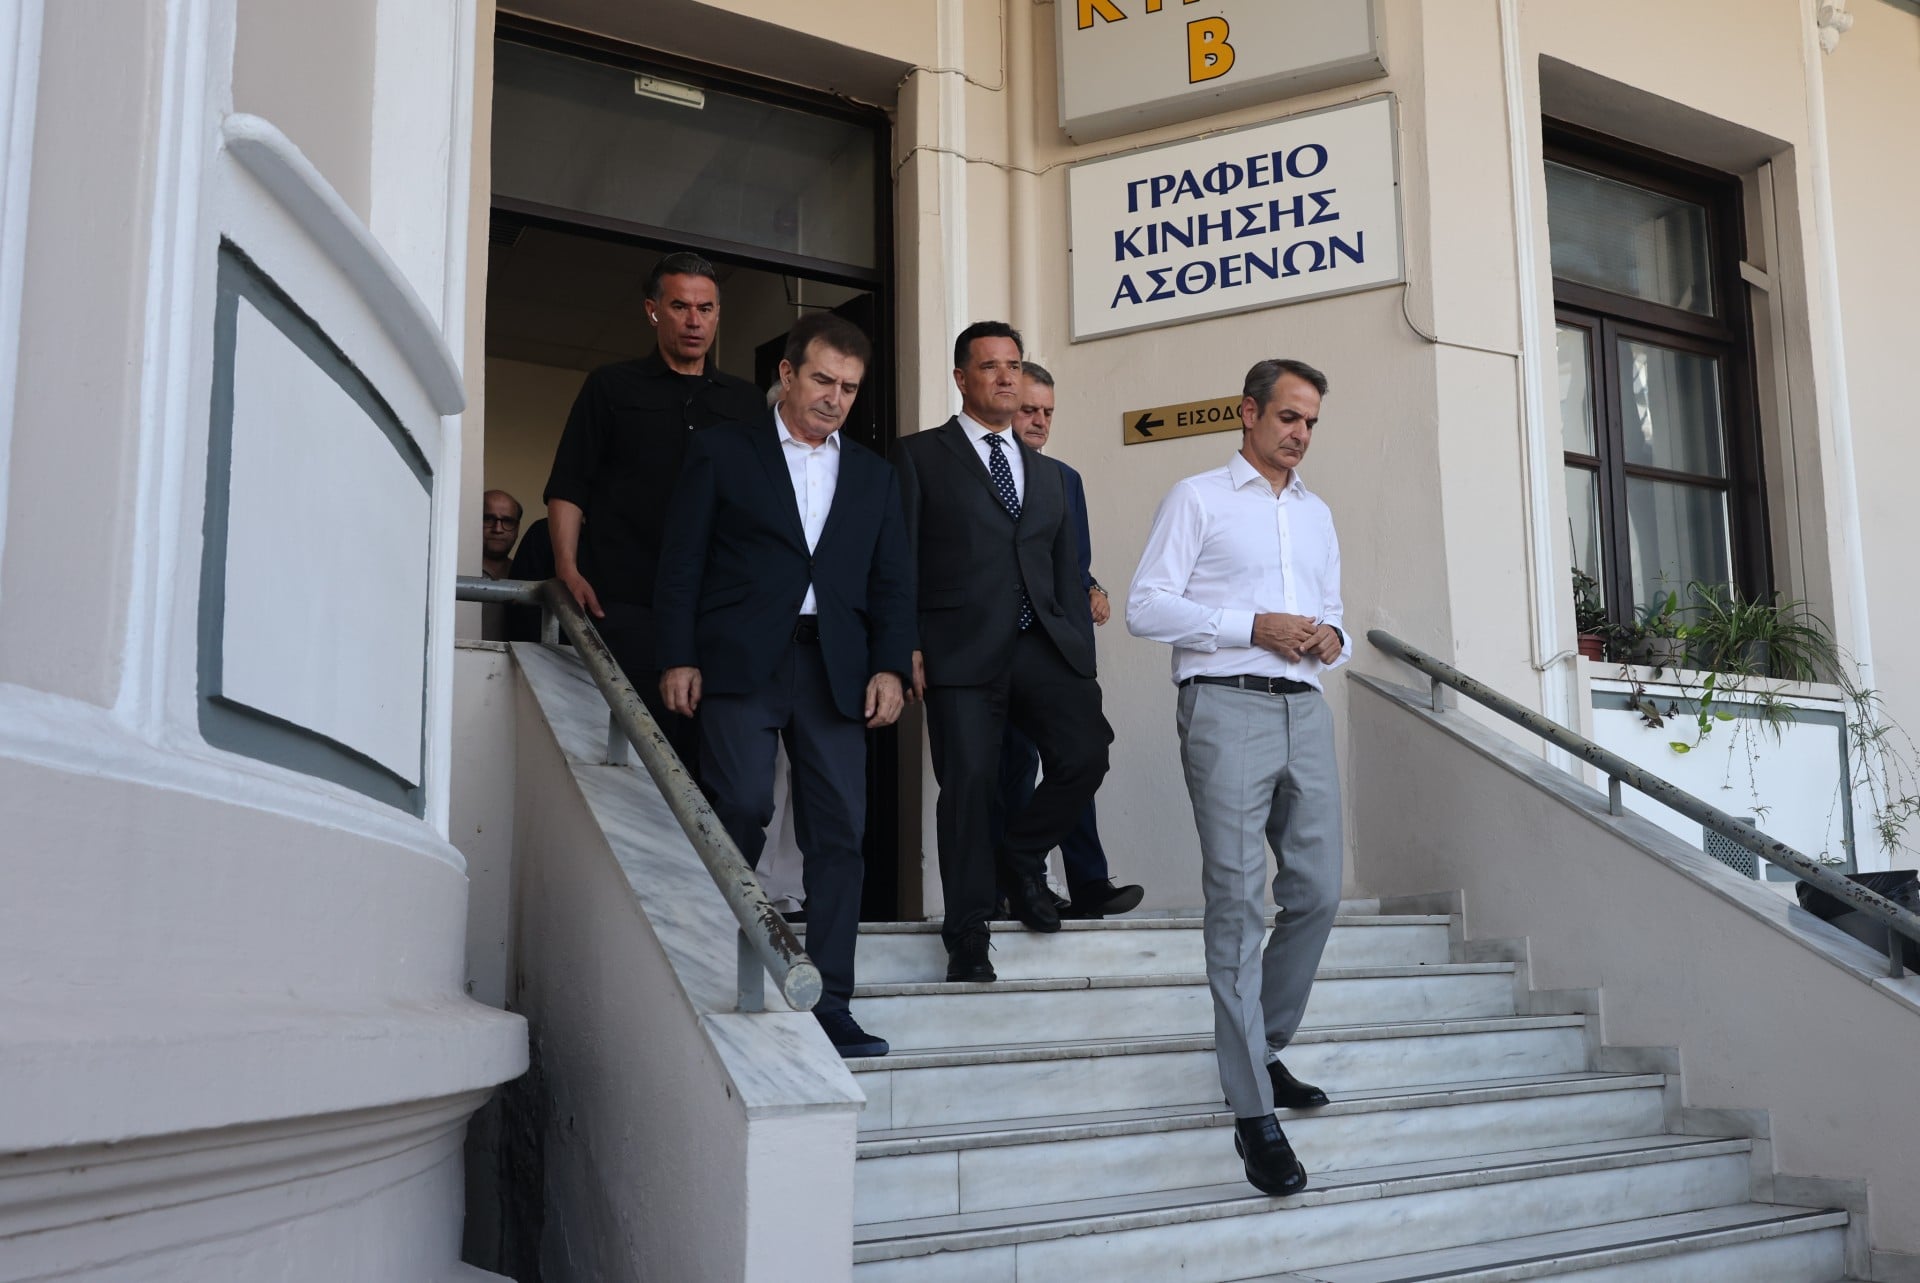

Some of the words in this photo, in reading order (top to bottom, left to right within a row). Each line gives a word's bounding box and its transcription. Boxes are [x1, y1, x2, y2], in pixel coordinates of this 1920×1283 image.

[1187, 17, 1235, 84] Β
[1128, 143, 1328, 213] ΓΡΑΦΕΙΟ
[1115, 188, 1340, 262] ΚΙΝΗΣΗΣ
[1111, 231, 1365, 309] ΑΣΘΕΝΩΝ
